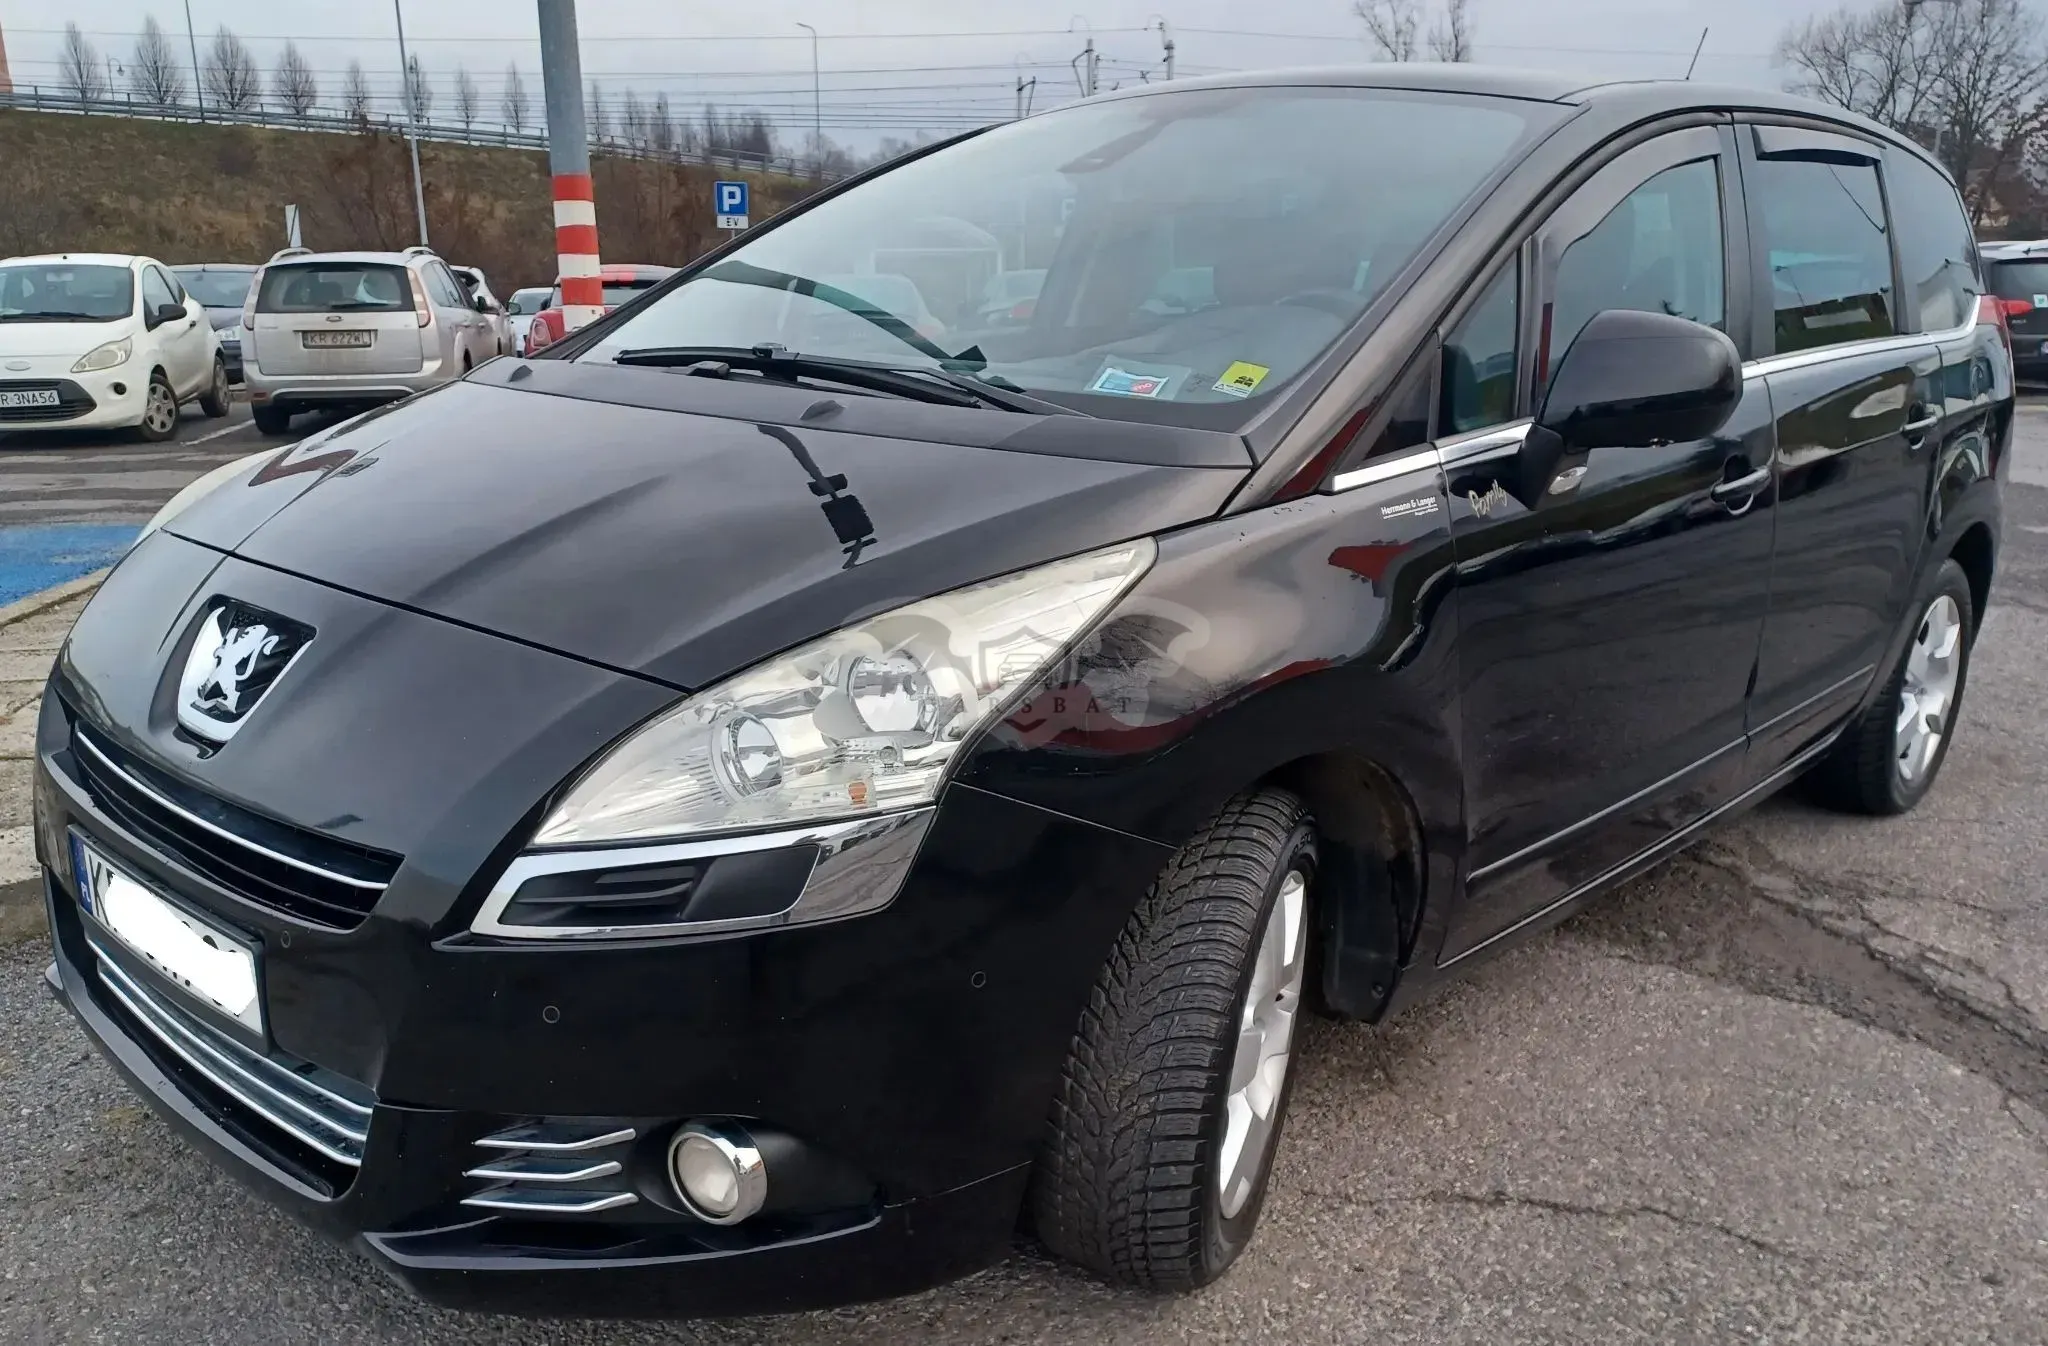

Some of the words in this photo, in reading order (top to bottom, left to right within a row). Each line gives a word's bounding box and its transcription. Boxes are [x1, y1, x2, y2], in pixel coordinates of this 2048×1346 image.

[722, 185, 742, 212] P
[726, 217, 740, 227] EV
[310, 332, 327, 344] KR
[13, 392, 56, 405] 3NA56
